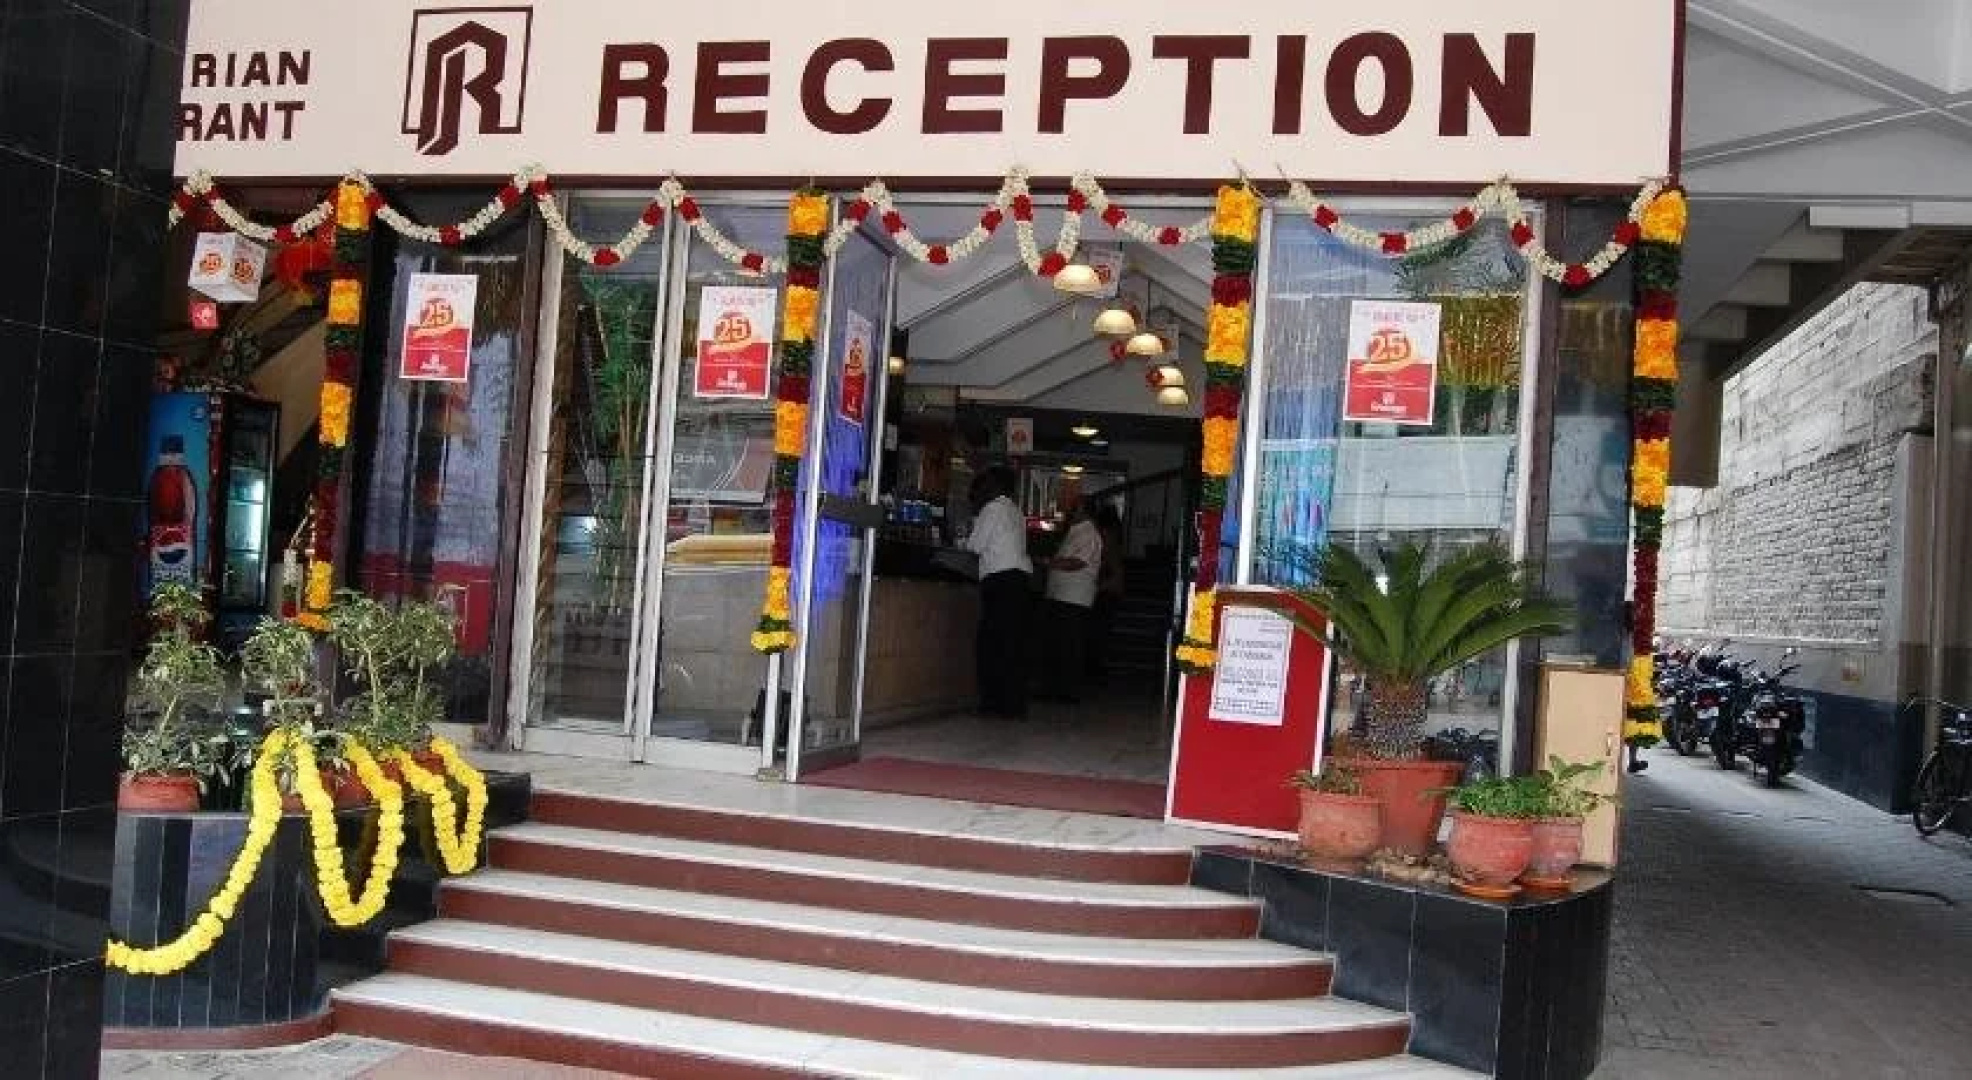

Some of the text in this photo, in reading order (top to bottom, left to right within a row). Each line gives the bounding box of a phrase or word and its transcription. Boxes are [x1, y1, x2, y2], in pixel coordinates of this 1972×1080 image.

[191, 50, 311, 88] RIAN
[595, 30, 1537, 137] RECEPTION
[176, 100, 306, 142] RANT
[717, 315, 752, 343] 25
[1368, 333, 1411, 364] 25
